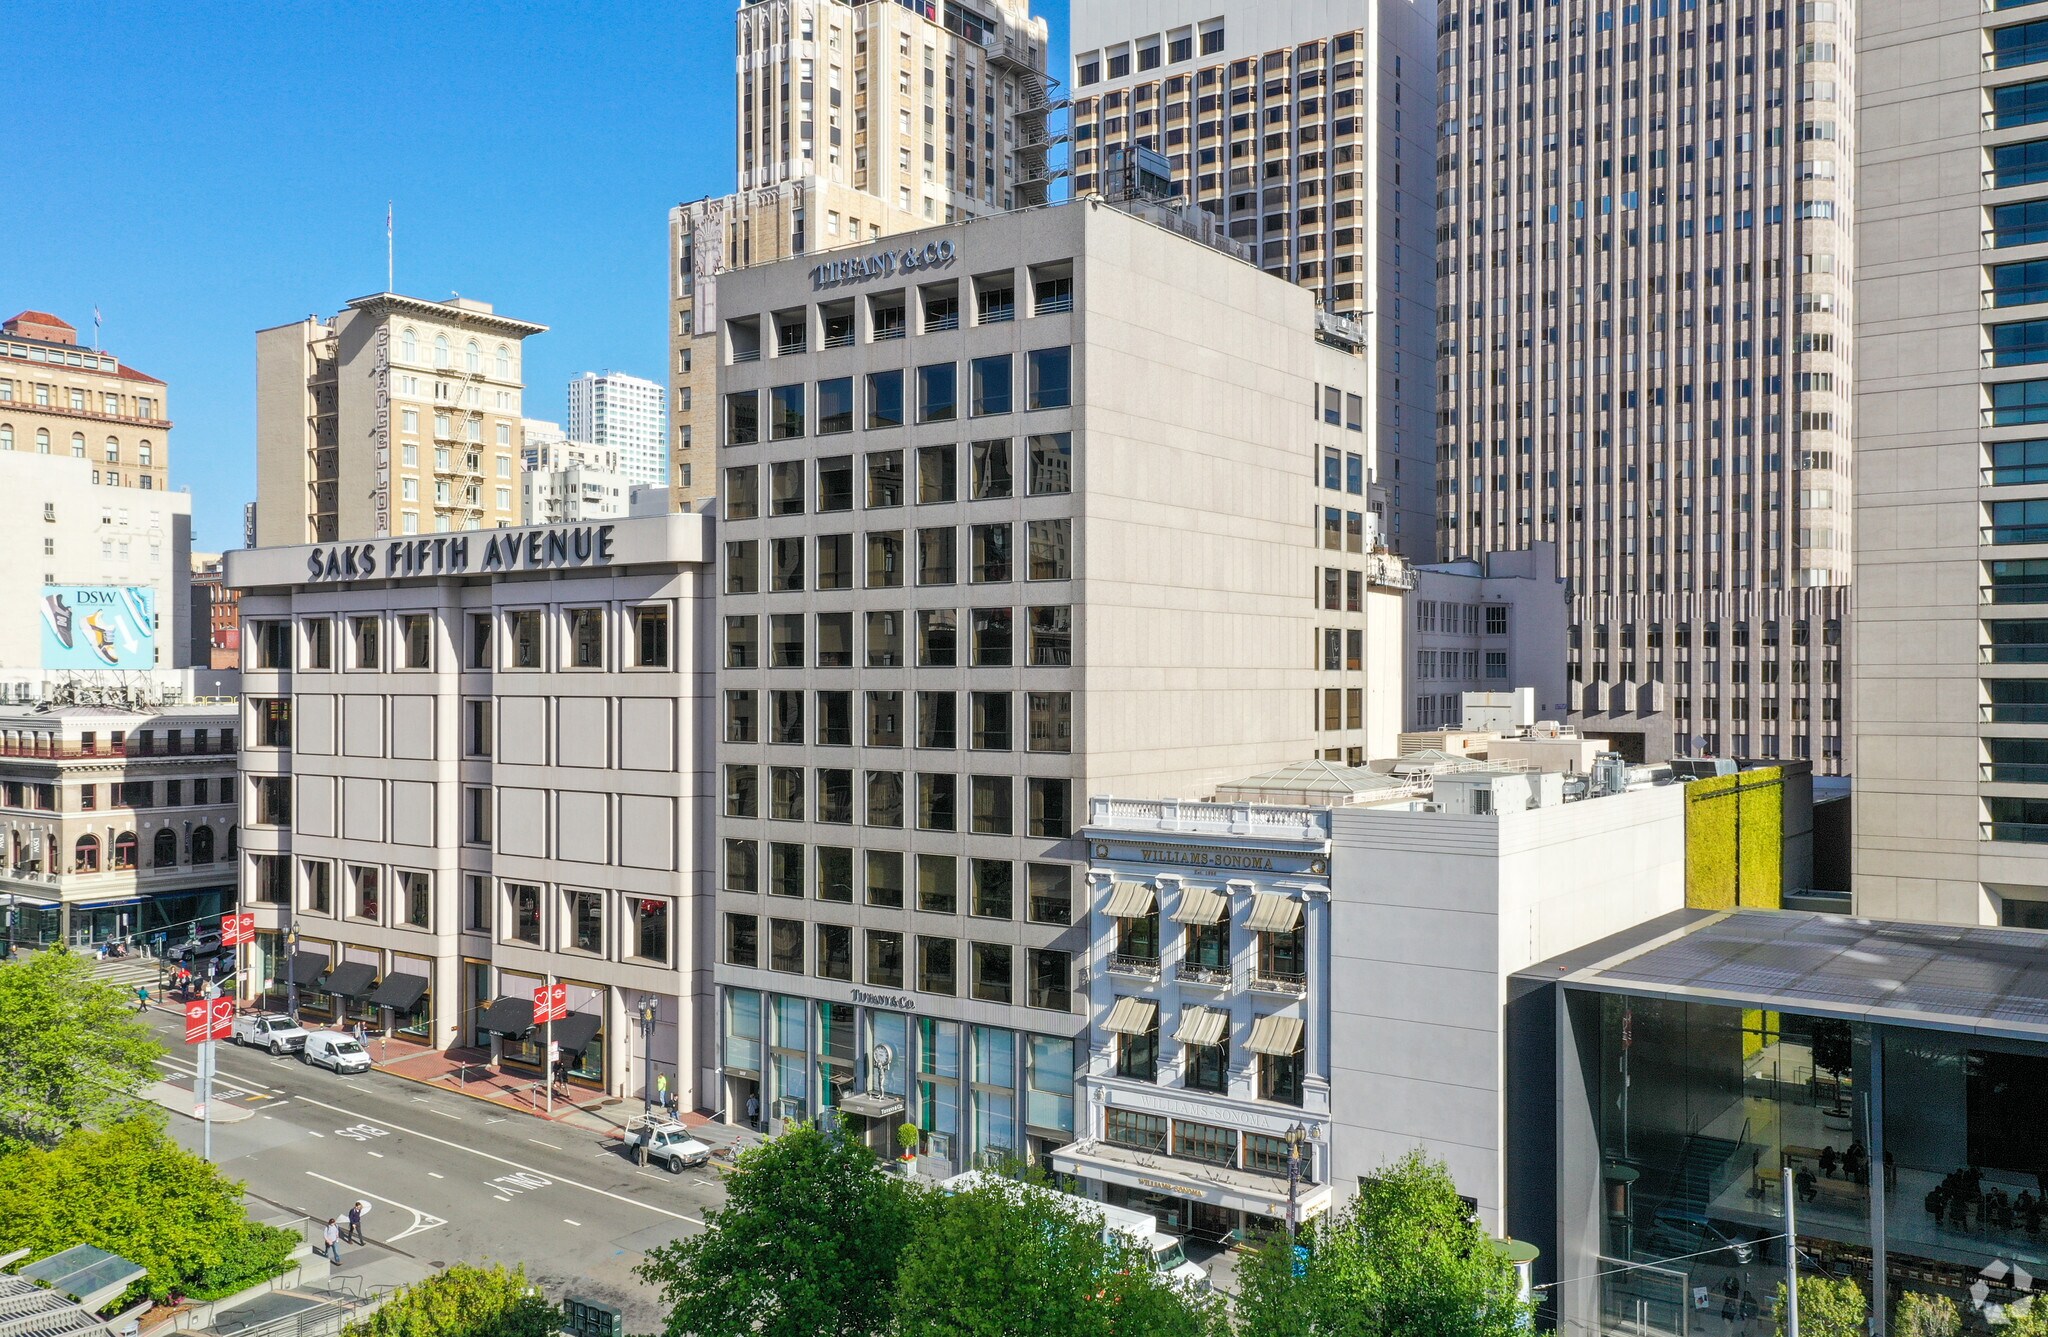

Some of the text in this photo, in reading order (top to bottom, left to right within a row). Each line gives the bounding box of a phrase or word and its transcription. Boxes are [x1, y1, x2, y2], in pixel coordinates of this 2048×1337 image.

[814, 249, 900, 284] TIFFANY
[905, 247, 921, 268] &
[376, 327, 388, 531] CHANCELLOR
[312, 525, 615, 577] SAKS FIFTH AVENUE
[77, 591, 116, 603] DSW
[1141, 849, 1273, 870] WILLIAMS-SONOMA
[1141, 1095, 1270, 1128] WILLIAMS-SONOMA
[334, 1123, 391, 1142] BUS
[483, 1172, 553, 1196] ONLY
[1138, 1178, 1203, 1197] WILLIAMS-SONOMA
